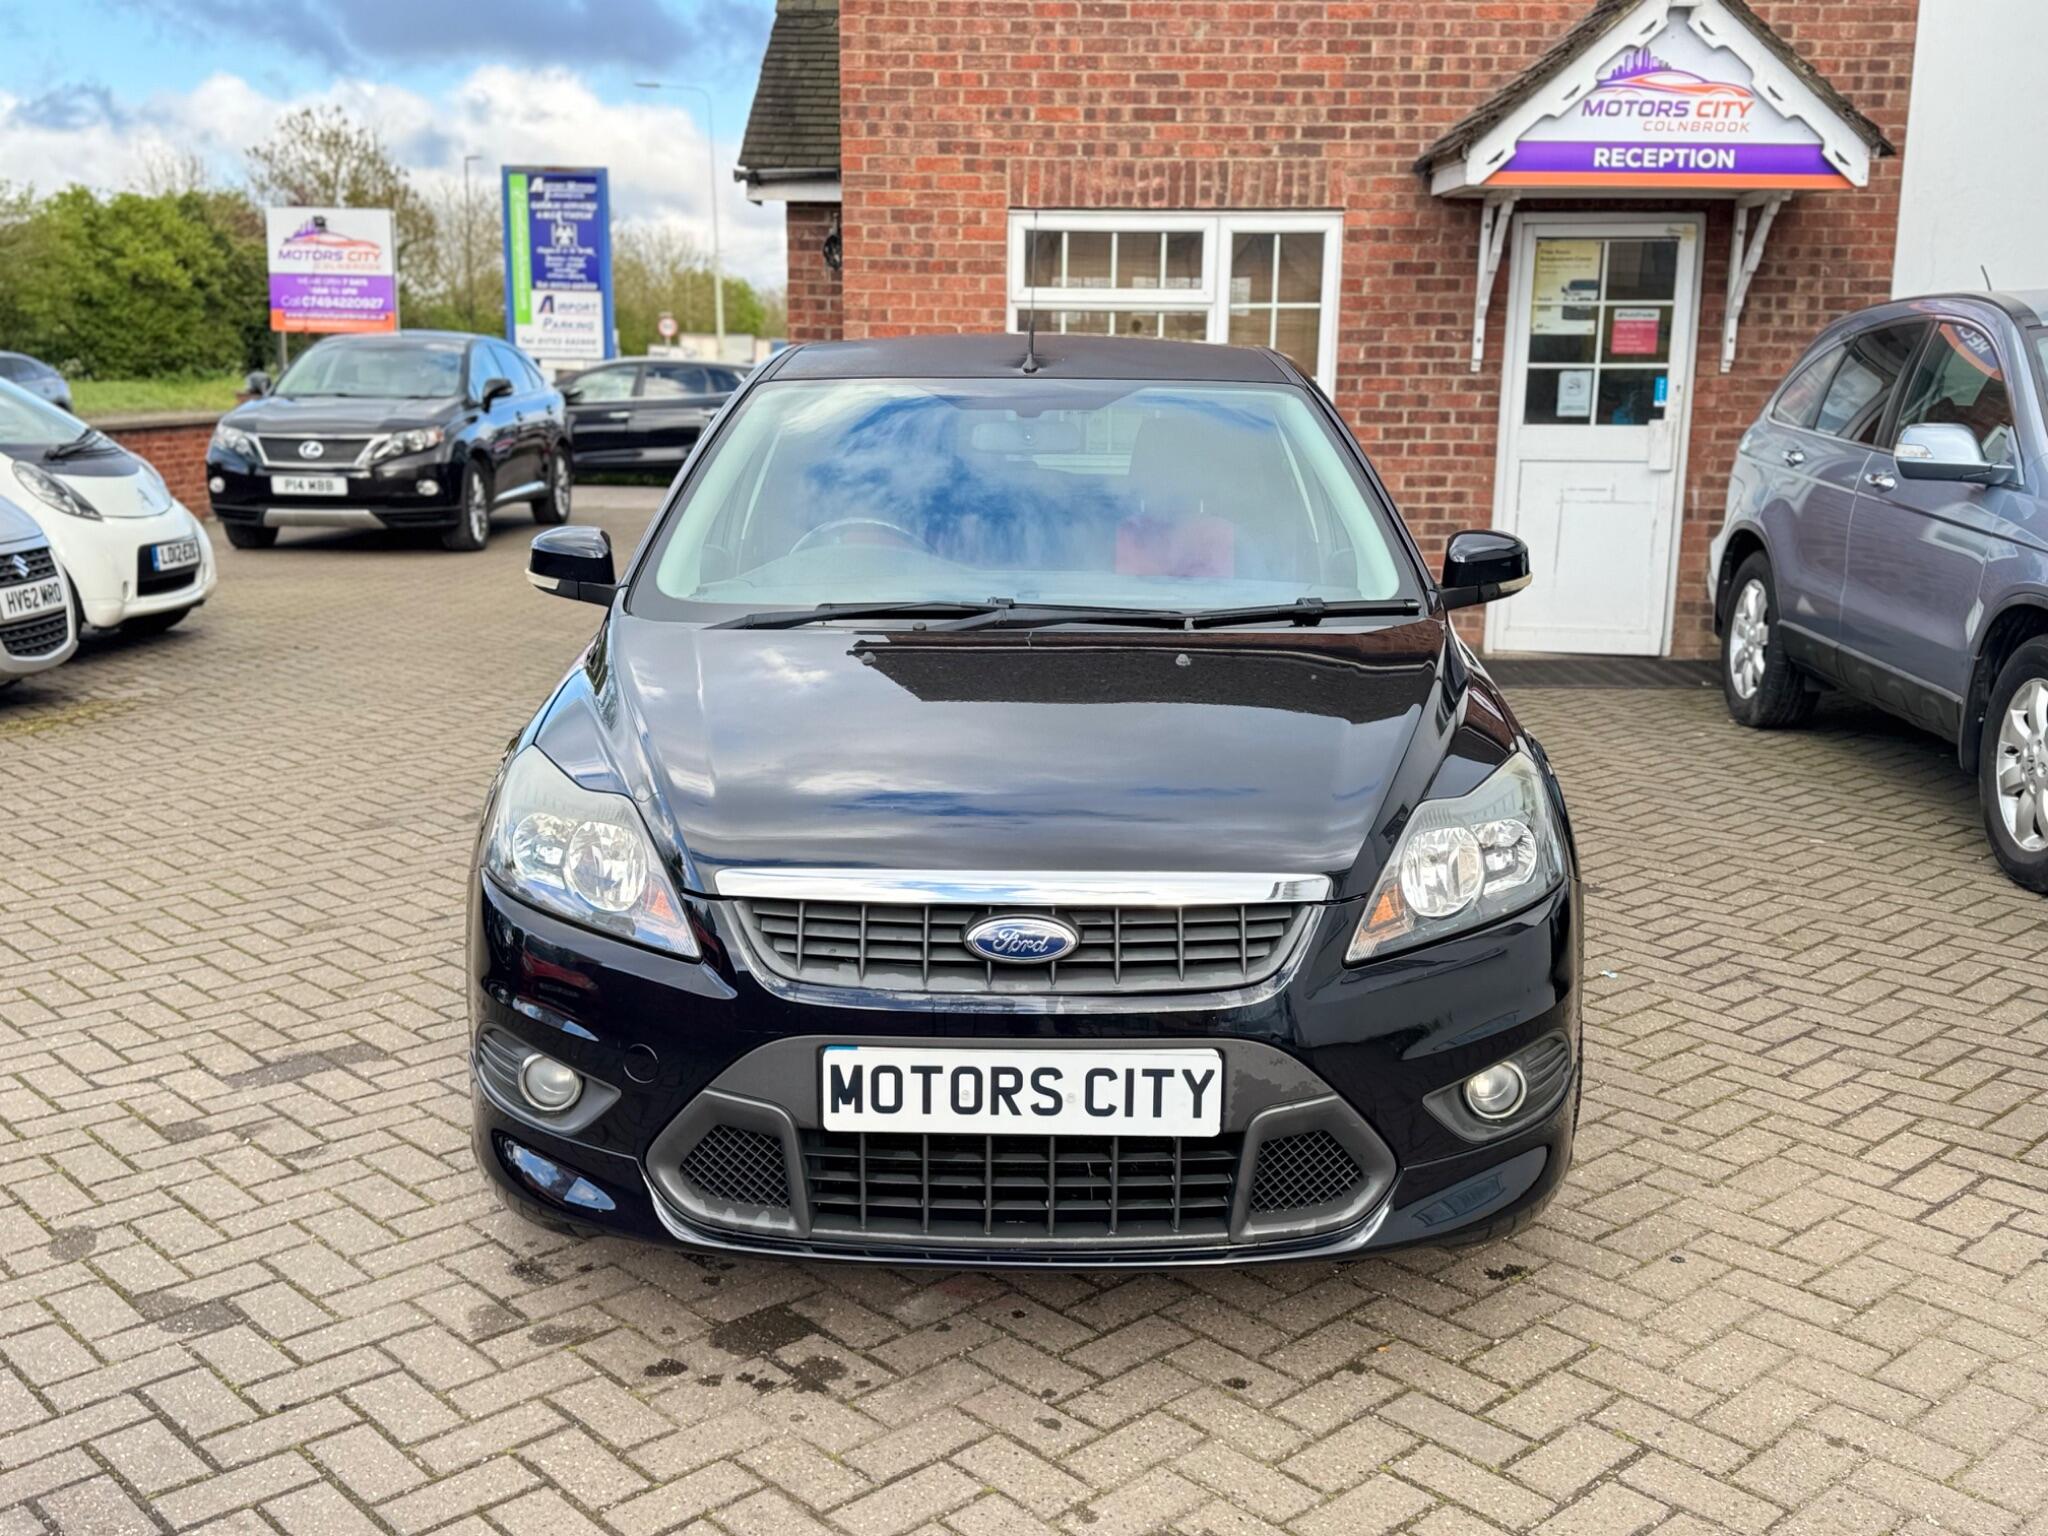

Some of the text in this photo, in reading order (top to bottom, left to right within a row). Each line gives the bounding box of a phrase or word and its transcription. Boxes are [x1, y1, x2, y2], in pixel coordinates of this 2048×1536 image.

[1581, 99, 1754, 119] MOTORS CITY
[1642, 120, 1750, 133] COLNBROOK
[1593, 147, 1736, 169] RECEPTION
[278, 249, 381, 262] MOTORS CITY
[992, 927, 1049, 954] Ford
[830, 1063, 1216, 1119] MOTORS CITY
